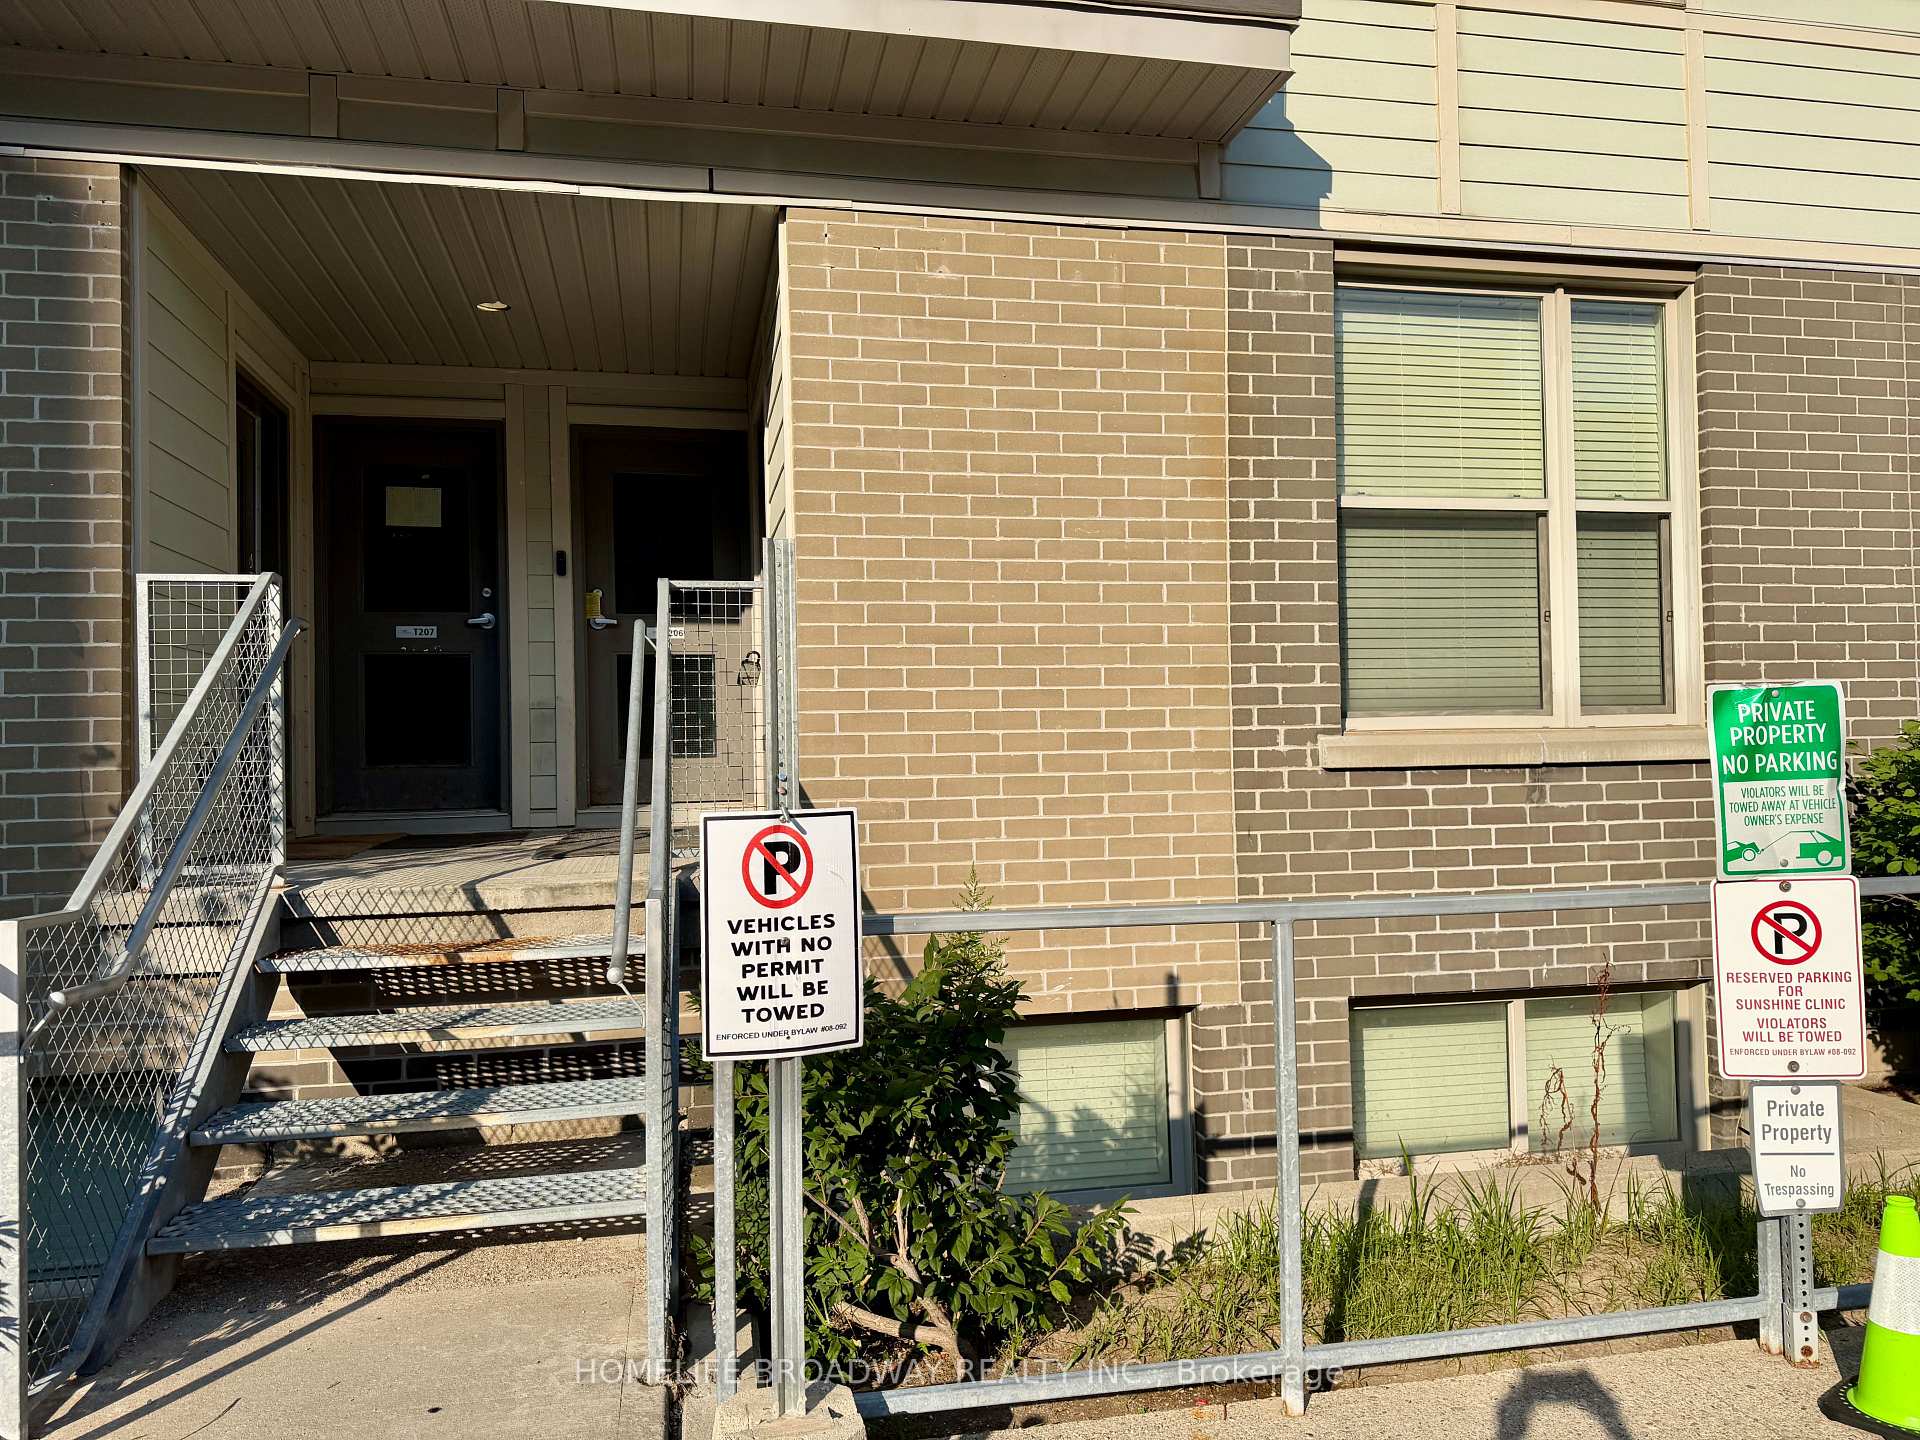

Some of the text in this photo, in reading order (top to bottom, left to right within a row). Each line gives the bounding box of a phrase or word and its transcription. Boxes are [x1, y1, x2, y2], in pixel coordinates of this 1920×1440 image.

[414, 628, 434, 637] T207
[1738, 700, 1816, 723] PRIVATE
[1730, 723, 1826, 746] PROPERTY
[1722, 751, 1837, 775] NO PARKING
[1741, 785, 1824, 798] VIOLATORS WILL BE
[1729, 797, 1836, 813] TOWED AWAY AT VEHICLE
[1744, 813, 1824, 827] OWNER'S EXPENSE
[727, 914, 836, 934] VEHICLES
[731, 936, 832, 957] WITH NO
[742, 958, 824, 978] PERMIT
[1726, 972, 1852, 983] RESERVED PARKING
[737, 980, 828, 1001] WILL BE
[1778, 985, 1803, 997] FOR
[1736, 999, 1846, 1010] SUNSHINE CLINIC
[742, 1003, 824, 1023] TOWED
[716, 1023, 847, 1040] ENFORCED UNDER BYLAW #08-092
[1757, 1018, 1827, 1029] VIOLATORS
[1742, 1030, 1842, 1043] WILL BE TOWED
[1729, 1048, 1769, 1056] ENFORCED
[1772, 1048, 1798, 1056] UNDER
[1800, 1048, 1825, 1056] BYLAW
[1767, 1100, 1824, 1117] Private
[1762, 1124, 1832, 1144] Property
[1790, 1165, 1806, 1177] No
[1764, 1183, 1834, 1197] Trespassing
